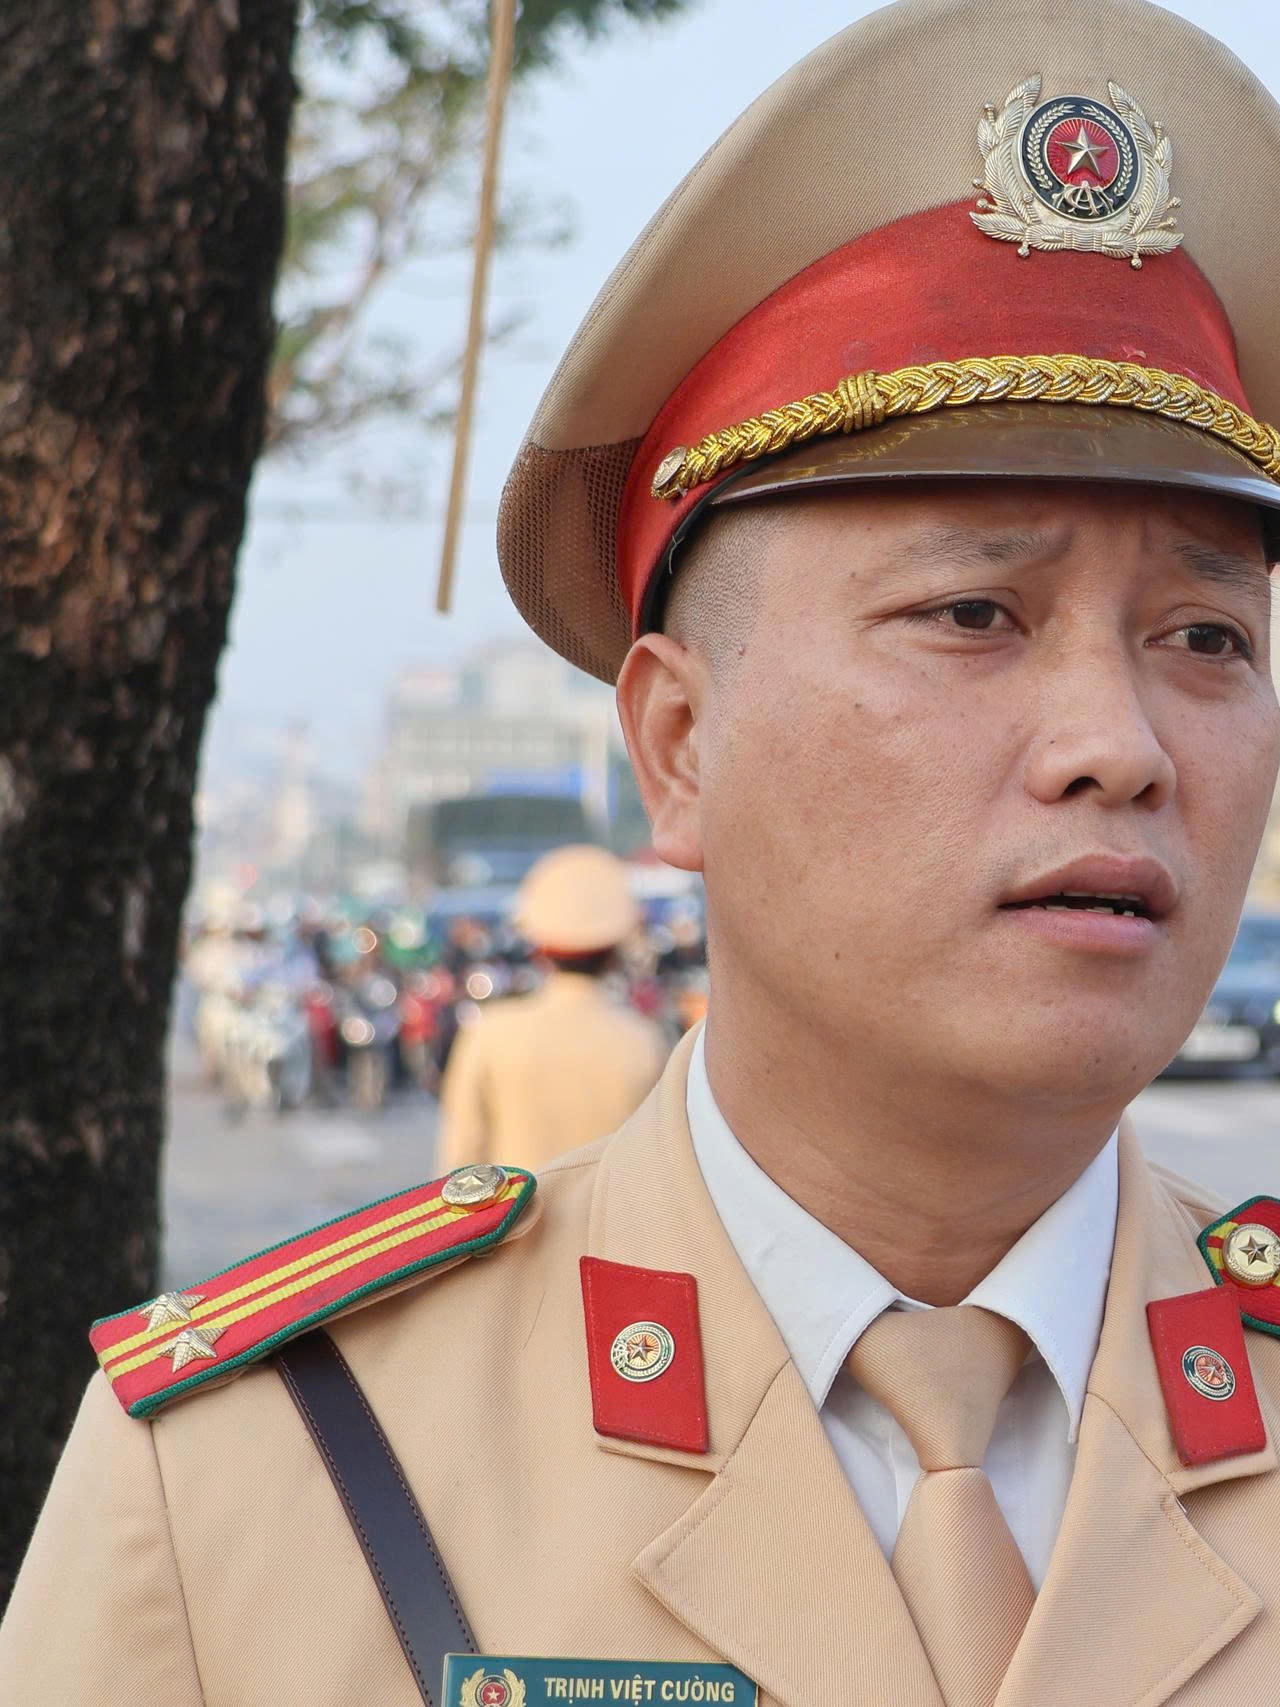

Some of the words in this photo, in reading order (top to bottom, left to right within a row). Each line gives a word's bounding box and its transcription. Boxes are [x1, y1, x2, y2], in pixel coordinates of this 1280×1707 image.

[544, 1677, 605, 1704] TRỊNH
[611, 1674, 657, 1706] VIỆT
[662, 1674, 735, 1703] CƯỜNG
